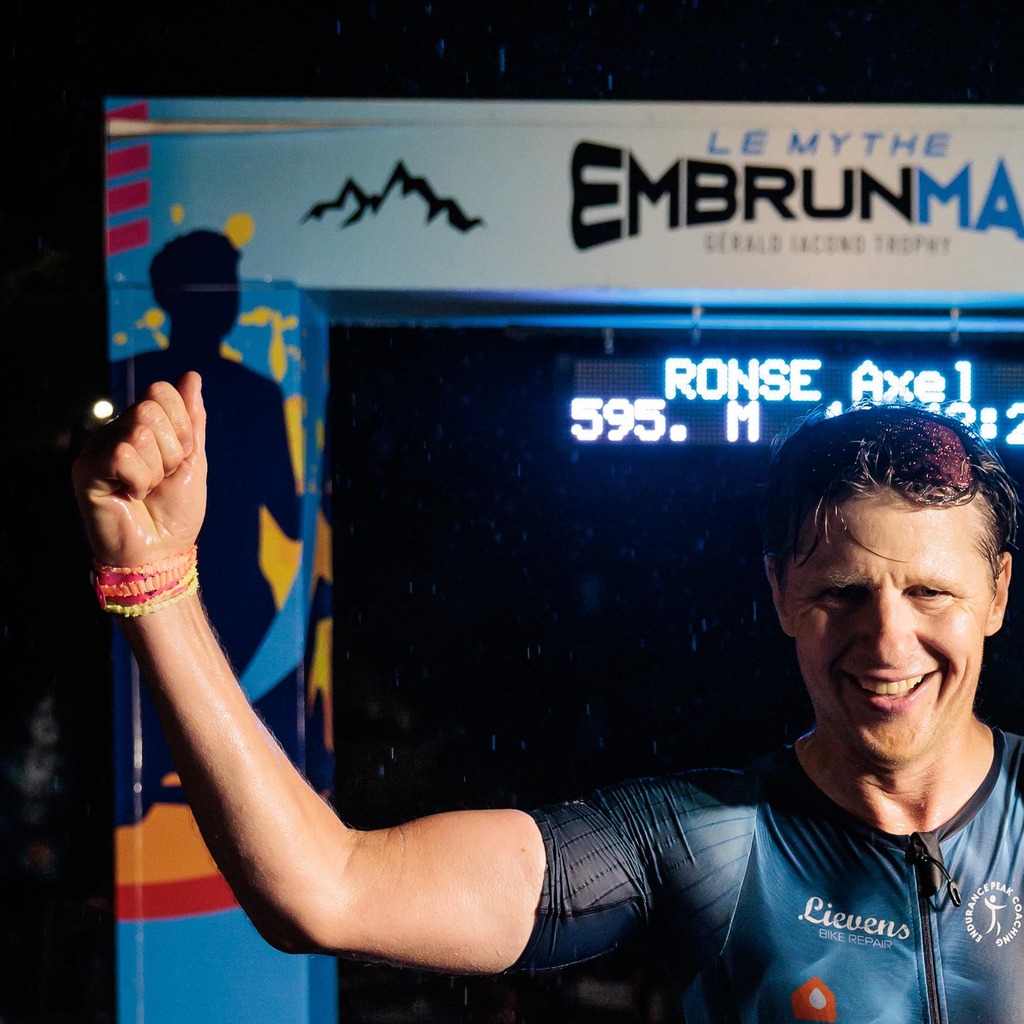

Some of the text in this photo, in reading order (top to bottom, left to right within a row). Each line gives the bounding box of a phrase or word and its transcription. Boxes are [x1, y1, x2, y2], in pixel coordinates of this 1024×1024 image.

[707, 131, 952, 157] LE MYTHE
[875, 234, 952, 255] TROPHY
[664, 357, 973, 402] RONSE Axel
[570, 398, 760, 443] 595. M
[798, 896, 911, 940] Lievens
[965, 881, 1023, 947] ENDURANCE PEAK COACHING
[819, 928, 894, 950] BIKE REPAIR
